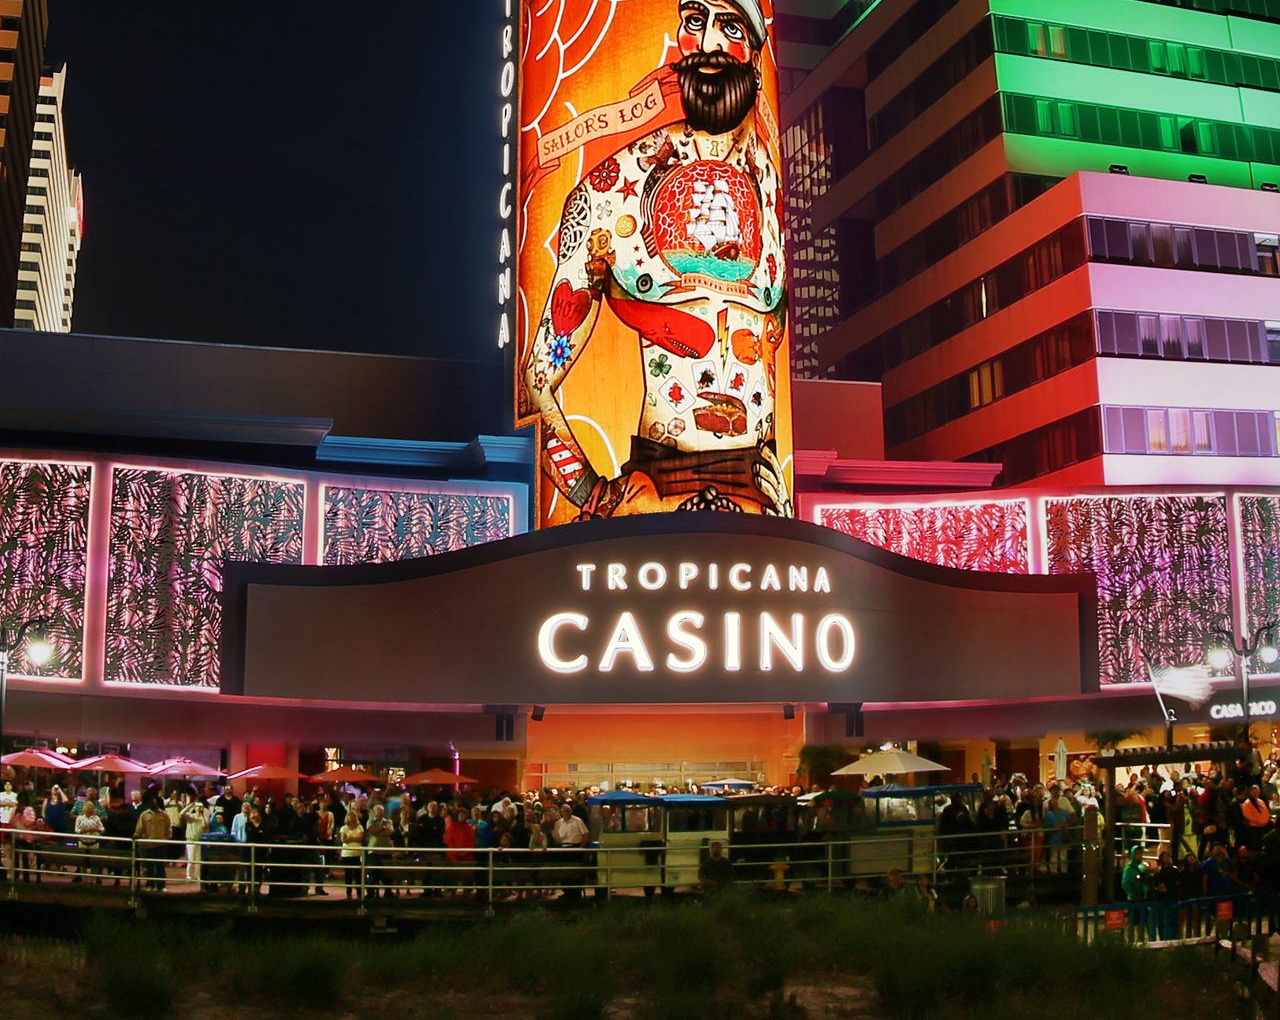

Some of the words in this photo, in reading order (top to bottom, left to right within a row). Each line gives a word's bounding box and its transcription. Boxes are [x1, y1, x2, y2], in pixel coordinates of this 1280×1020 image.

[543, 113, 609, 156] SAILOR'S
[618, 92, 658, 124] LOG
[576, 562, 832, 593] TROPICANA
[537, 611, 856, 673] CASINO
[1210, 703, 1244, 719] CASA
